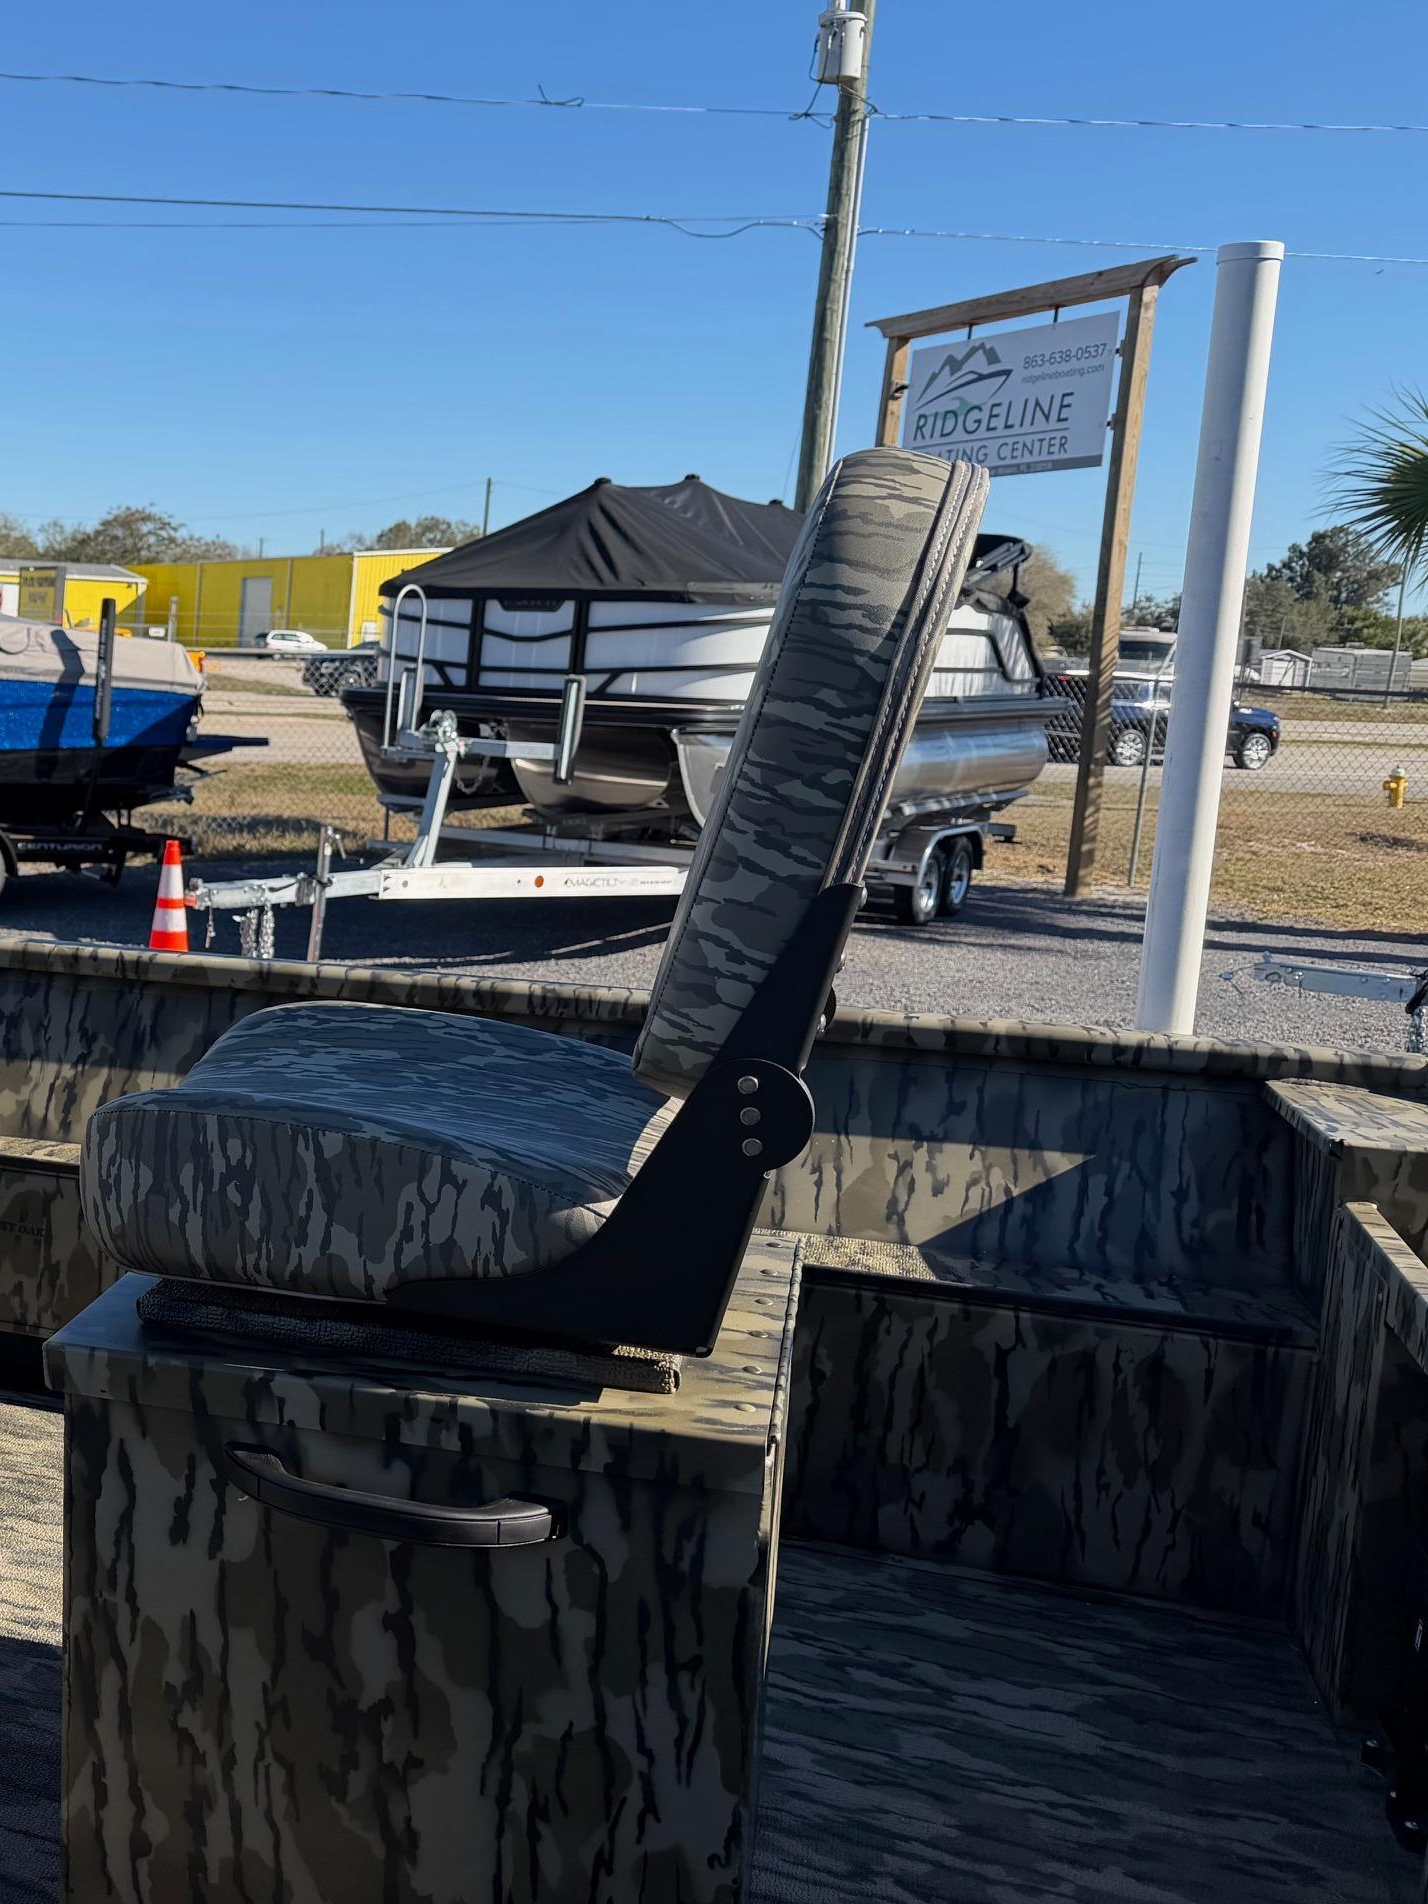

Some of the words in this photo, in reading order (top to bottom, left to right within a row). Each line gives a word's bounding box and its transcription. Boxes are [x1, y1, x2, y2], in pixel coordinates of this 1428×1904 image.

[1023, 342, 1107, 369] 863-638-0537
[913, 391, 1076, 442] RIDGELINE
[997, 435, 1069, 460] CENTER
